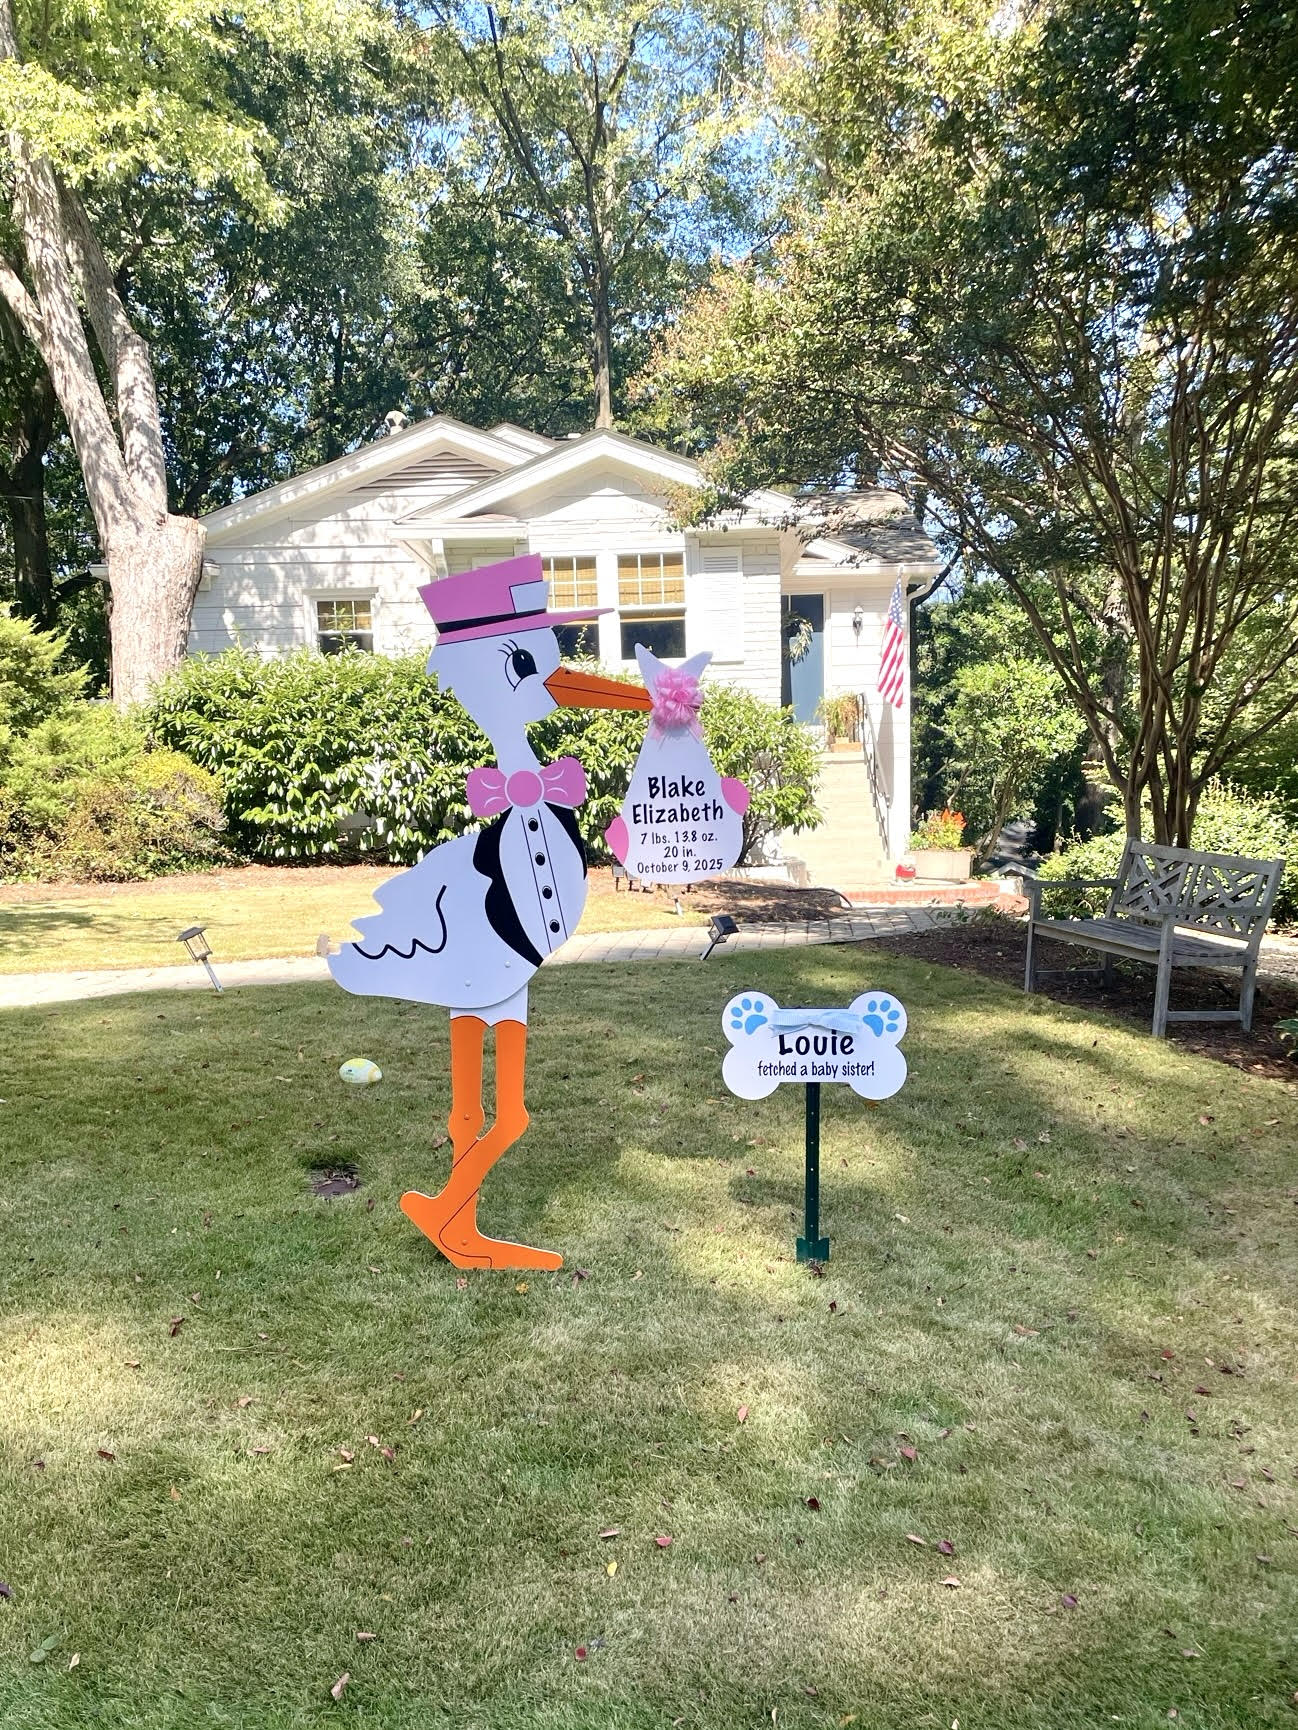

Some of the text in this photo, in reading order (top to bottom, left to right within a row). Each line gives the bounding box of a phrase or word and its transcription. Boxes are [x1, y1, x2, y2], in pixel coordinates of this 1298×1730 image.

[648, 775, 706, 799] Blake
[632, 799, 724, 825] Elizabeth
[640, 830, 718, 845] 7 lbs. 13.8 oz.
[664, 845, 696, 858] 20 in.
[637, 858, 724, 874] October 9, 2025
[778, 1029, 855, 1056] Louie
[757, 1060, 875, 1079] fetched a baby sister!
